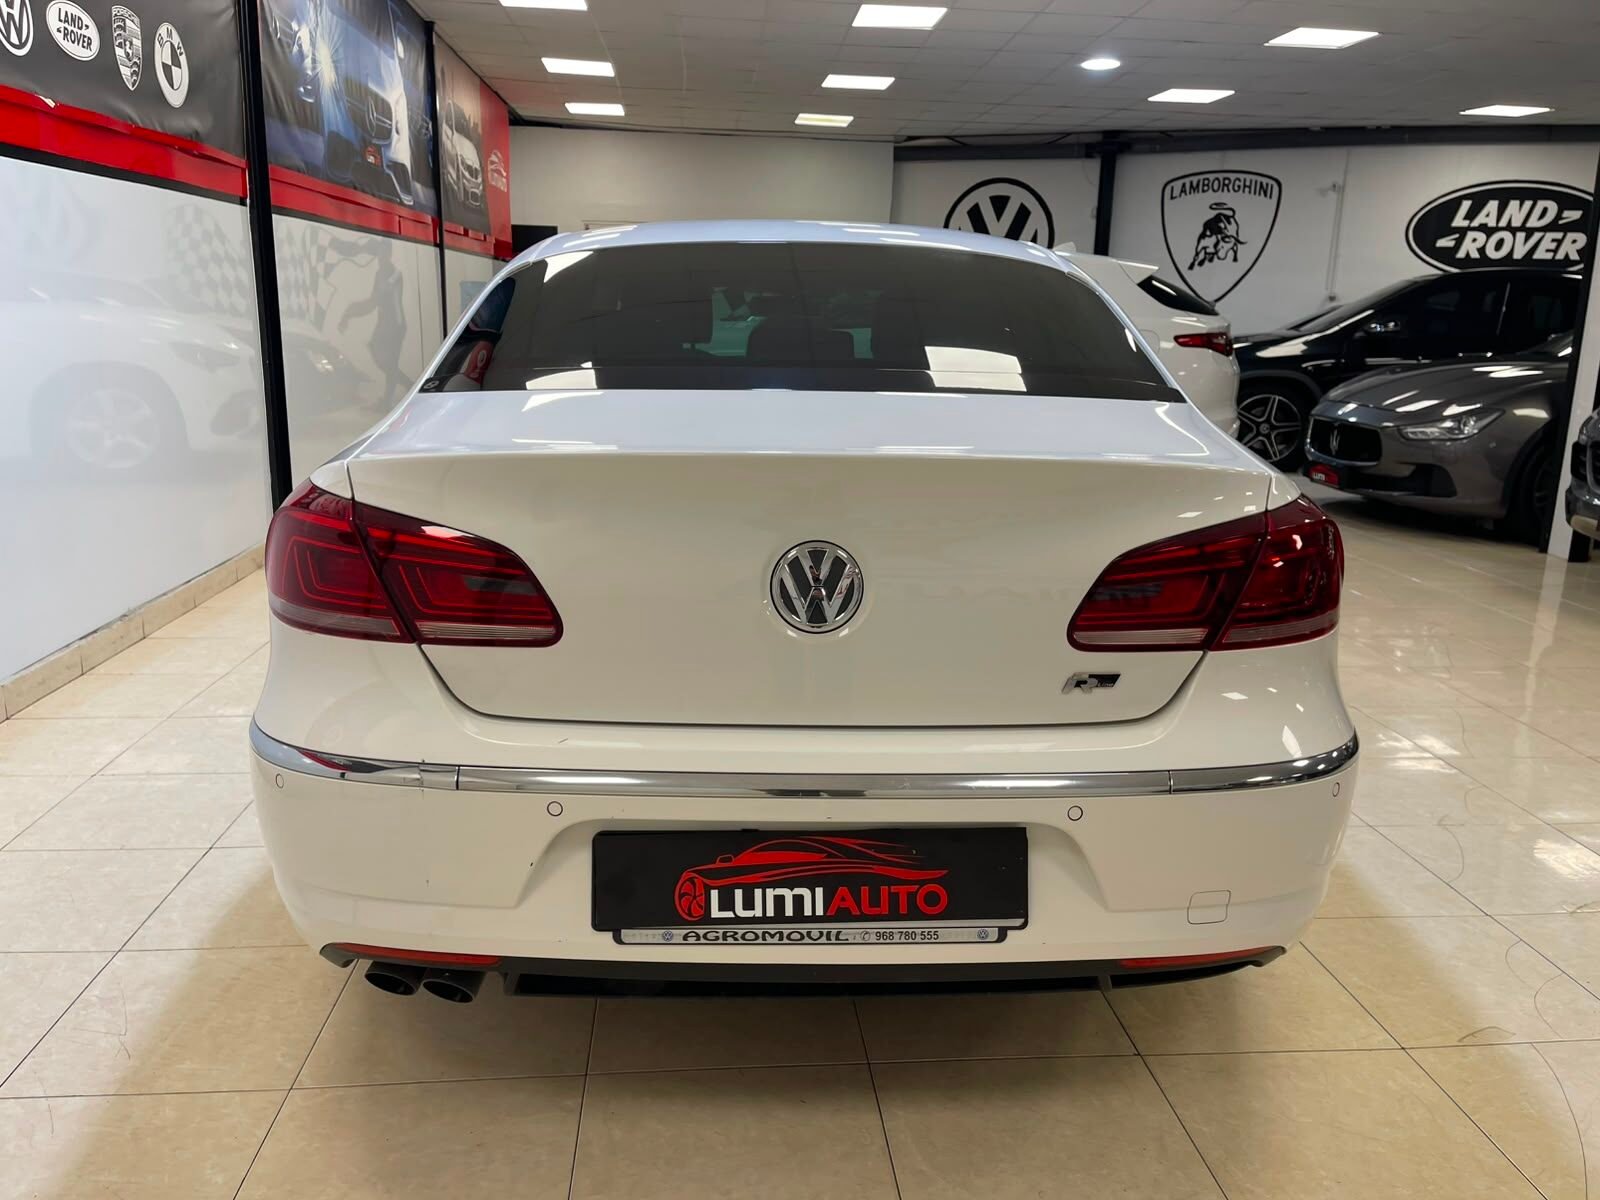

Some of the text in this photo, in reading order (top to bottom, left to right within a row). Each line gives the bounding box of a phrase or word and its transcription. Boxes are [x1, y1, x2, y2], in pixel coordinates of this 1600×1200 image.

[58, 8, 84, 31] LAND
[63, 26, 93, 51] ROVER
[157, 27, 184, 56] BMW
[1170, 177, 1274, 200] LAMBORGHINI
[1451, 199, 1559, 228] LAND
[1455, 230, 1587, 260] ROVER
[682, 929, 939, 942] AGROMOVIL 968 780 555
